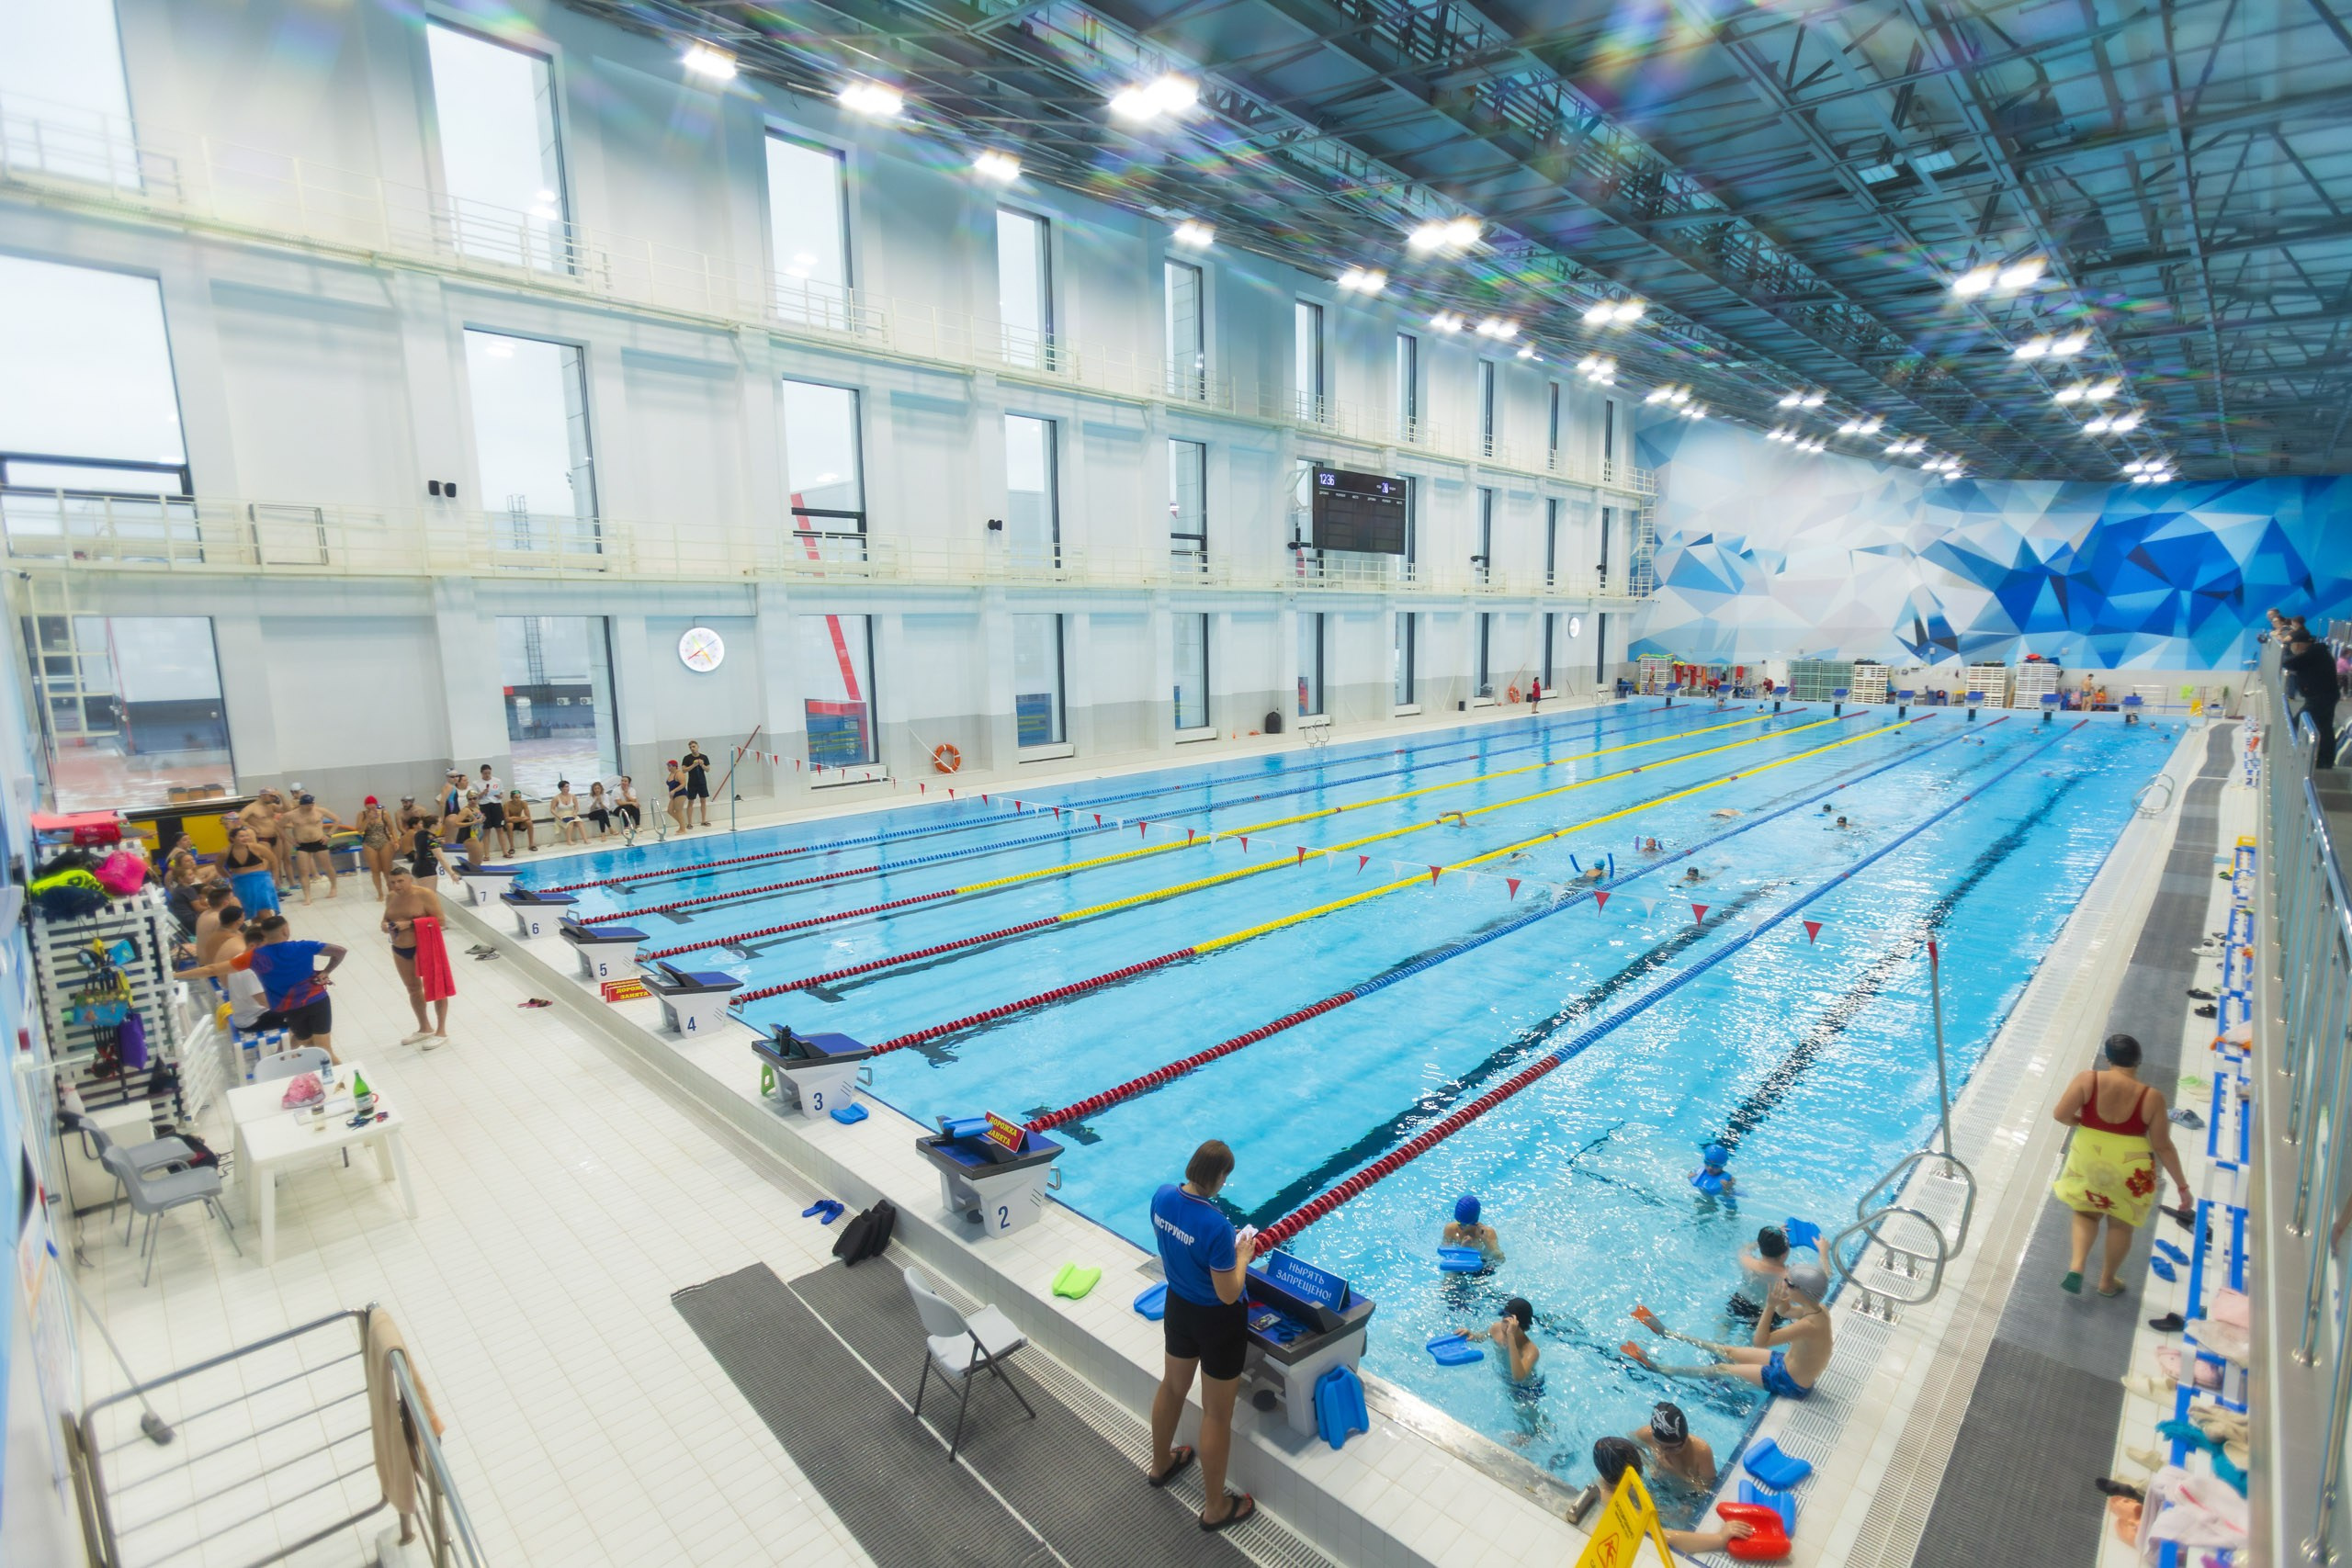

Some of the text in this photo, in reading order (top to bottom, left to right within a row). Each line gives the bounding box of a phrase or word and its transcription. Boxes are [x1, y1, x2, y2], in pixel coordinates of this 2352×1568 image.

[438, 866, 446, 876] 8
[480, 891, 487, 902] 7
[532, 922, 539, 935] 6
[599, 963, 608, 976] 5
[619, 991, 650, 1000] ЗАНЯТА
[687, 1016, 696, 1032] 4
[813, 1092, 823, 1111] 3
[988, 1115, 1018, 1137] ДОРОЖКА
[998, 1205, 1011, 1230] 2
[1288, 1261, 1325, 1285] НЫРЯТЬ
[1275, 1269, 1332, 1302] ЗАПРЕЩЕНО!
